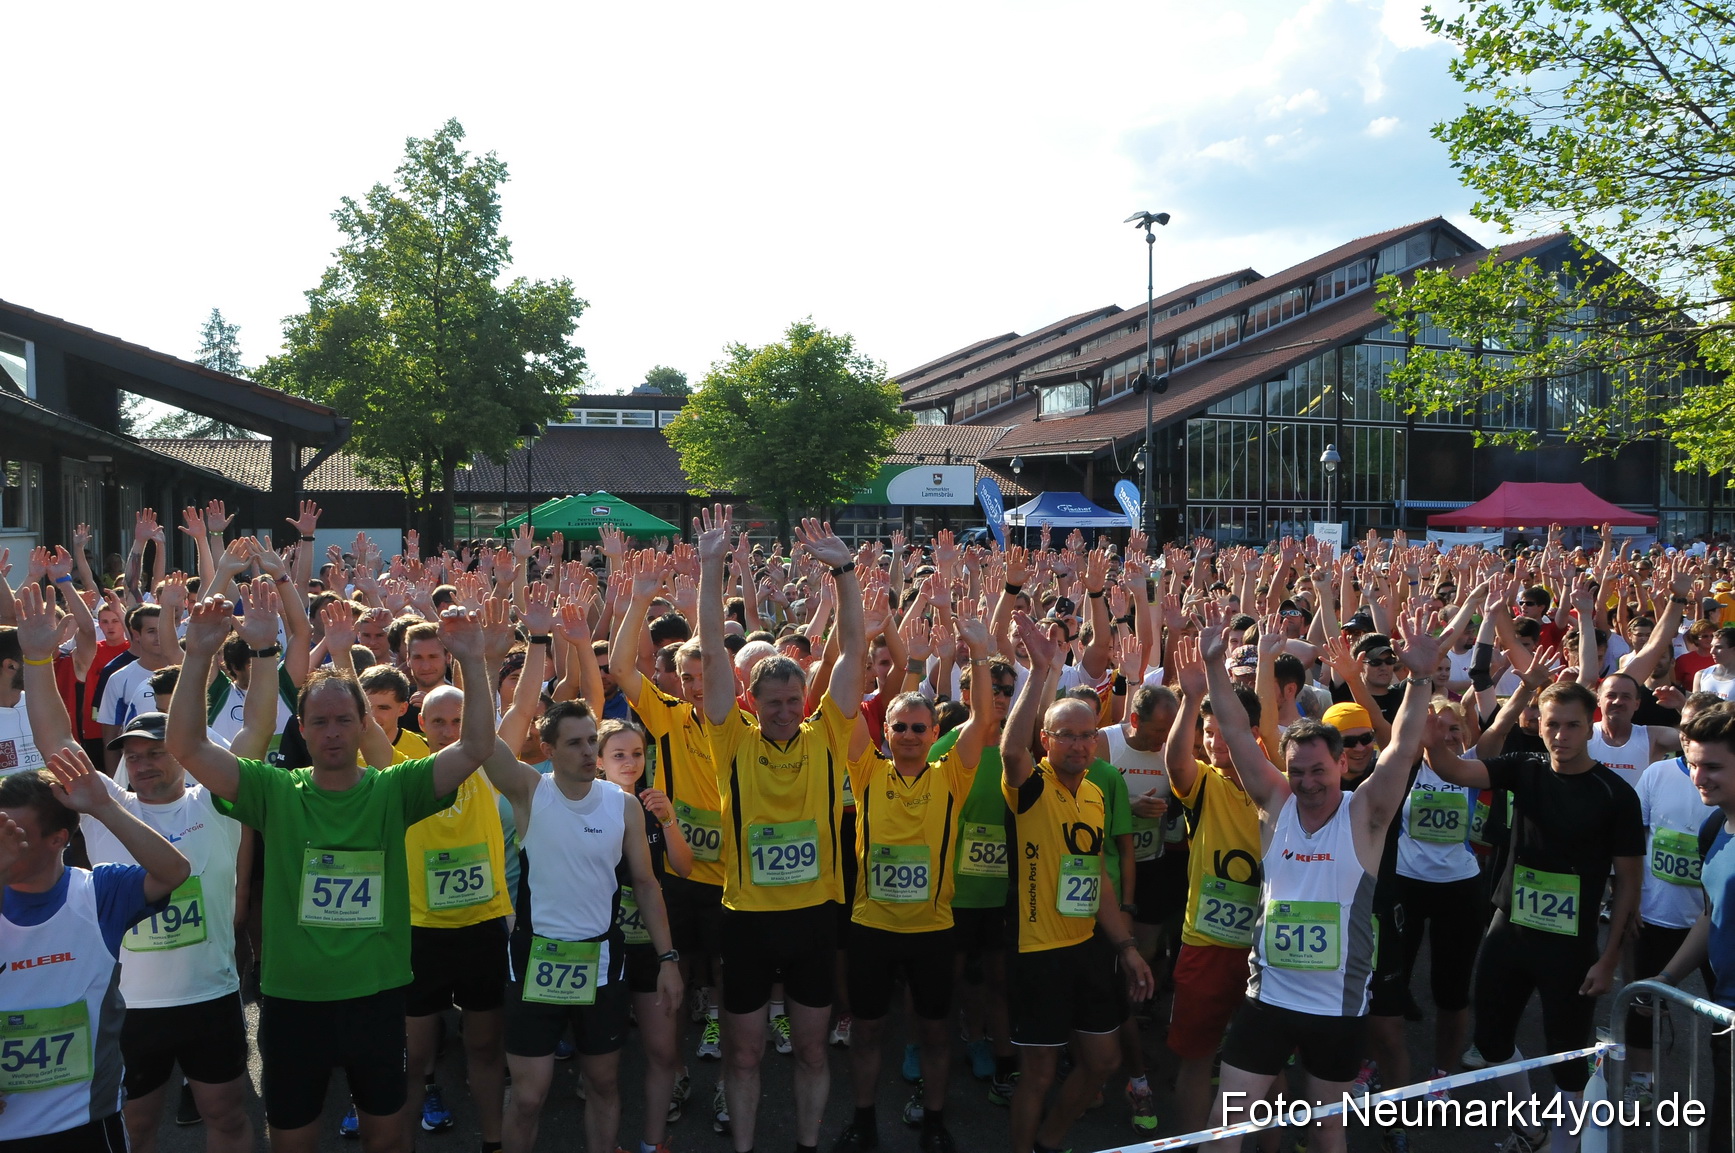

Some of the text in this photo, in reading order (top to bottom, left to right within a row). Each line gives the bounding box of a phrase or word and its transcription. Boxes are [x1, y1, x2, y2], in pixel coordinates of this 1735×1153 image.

[1057, 504, 1092, 512] Fischer
[0, 760, 17, 768] ORK
[1129, 768, 1165, 776] KLEBL
[584, 826, 603, 834] Stefan
[1417, 807, 1460, 830] 208
[676, 818, 720, 850] 300
[751, 842, 817, 871] 1299
[968, 841, 1008, 865] 582
[1295, 852, 1335, 863] KLEBL
[434, 865, 484, 895] 735
[871, 863, 928, 889] 1298
[1065, 876, 1099, 902] 228
[311, 877, 372, 909] 574
[1028, 862, 1037, 923] Deutsche Post
[1515, 886, 1577, 920] 1124
[1203, 898, 1254, 931] 232
[1274, 924, 1328, 953] 513
[11, 952, 77, 972] KLEBL
[535, 961, 588, 990] 875
[0, 1031, 75, 1073] 547
[12, 1071, 40, 1080] Wolfgang
